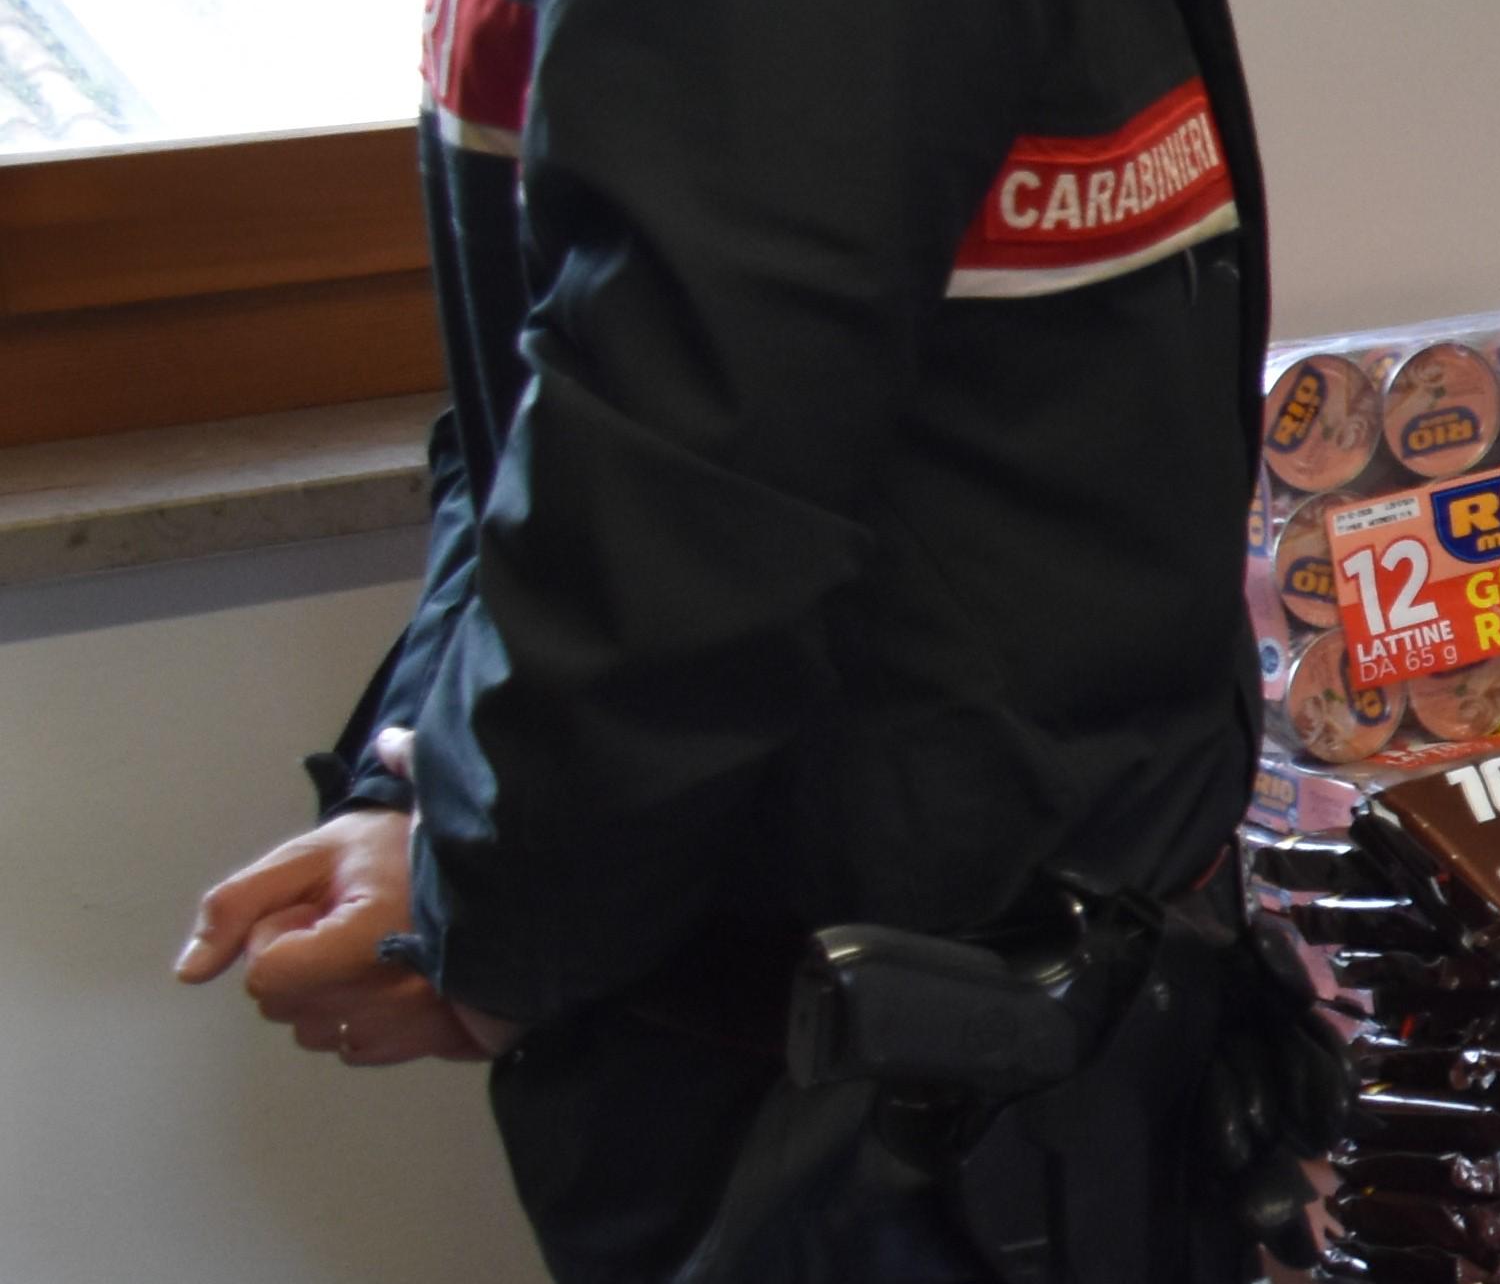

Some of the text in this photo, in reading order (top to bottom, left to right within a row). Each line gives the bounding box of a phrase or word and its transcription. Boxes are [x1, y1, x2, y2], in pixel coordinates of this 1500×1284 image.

[1001, 113, 1219, 231] CARABINIERI
[1342, 538, 1439, 637] 12
[1355, 620, 1455, 663] LATTINE
[1359, 645, 1459, 683] DA 65 g
